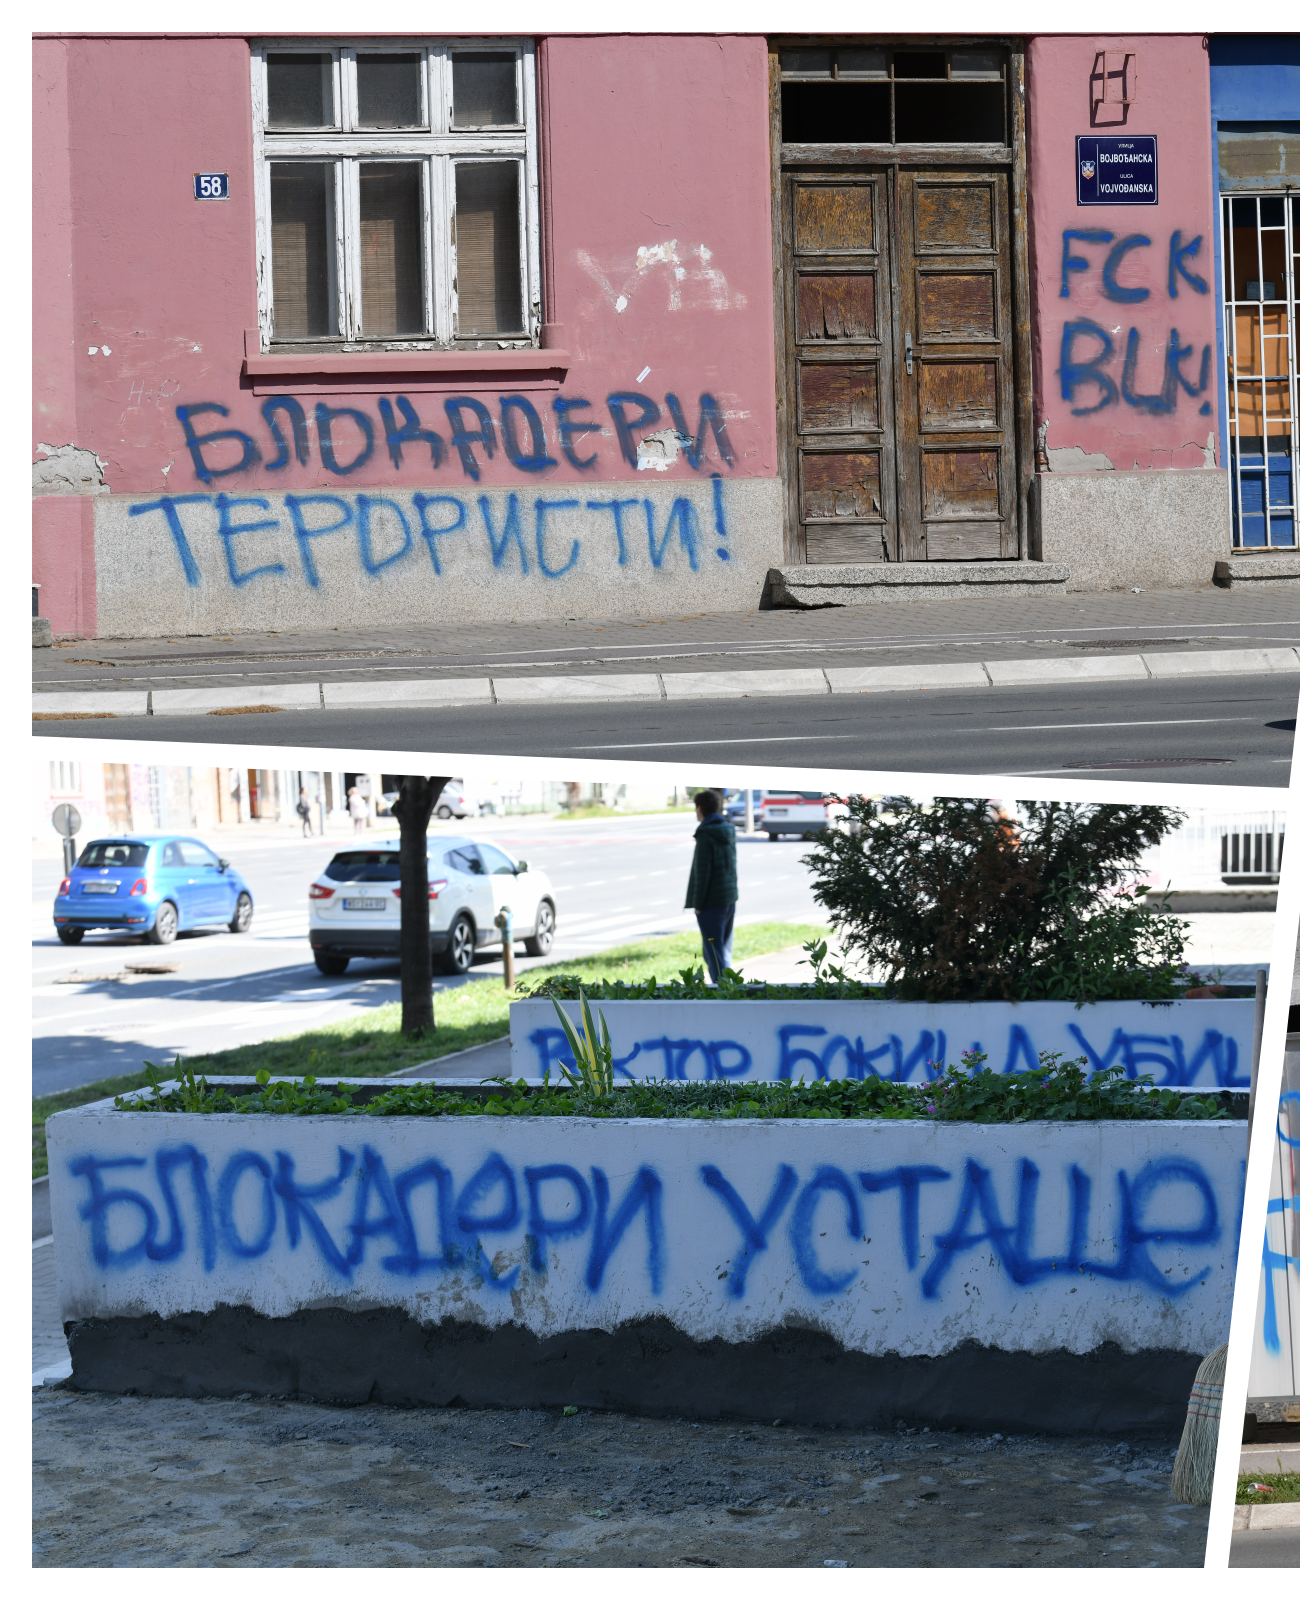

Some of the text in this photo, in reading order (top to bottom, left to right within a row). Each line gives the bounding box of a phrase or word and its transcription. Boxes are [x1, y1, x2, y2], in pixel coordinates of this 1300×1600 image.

[1100, 153, 1153, 163] ВОЈВОЂАНСКА
[200, 176, 222, 197] 58
[1100, 183, 1154, 193] VOJVOĐANSKA
[1059, 227, 1209, 305] FCK
[1059, 317, 1213, 417] BLK!
[127, 472, 734, 591] ТЕРОРИСТИ!
